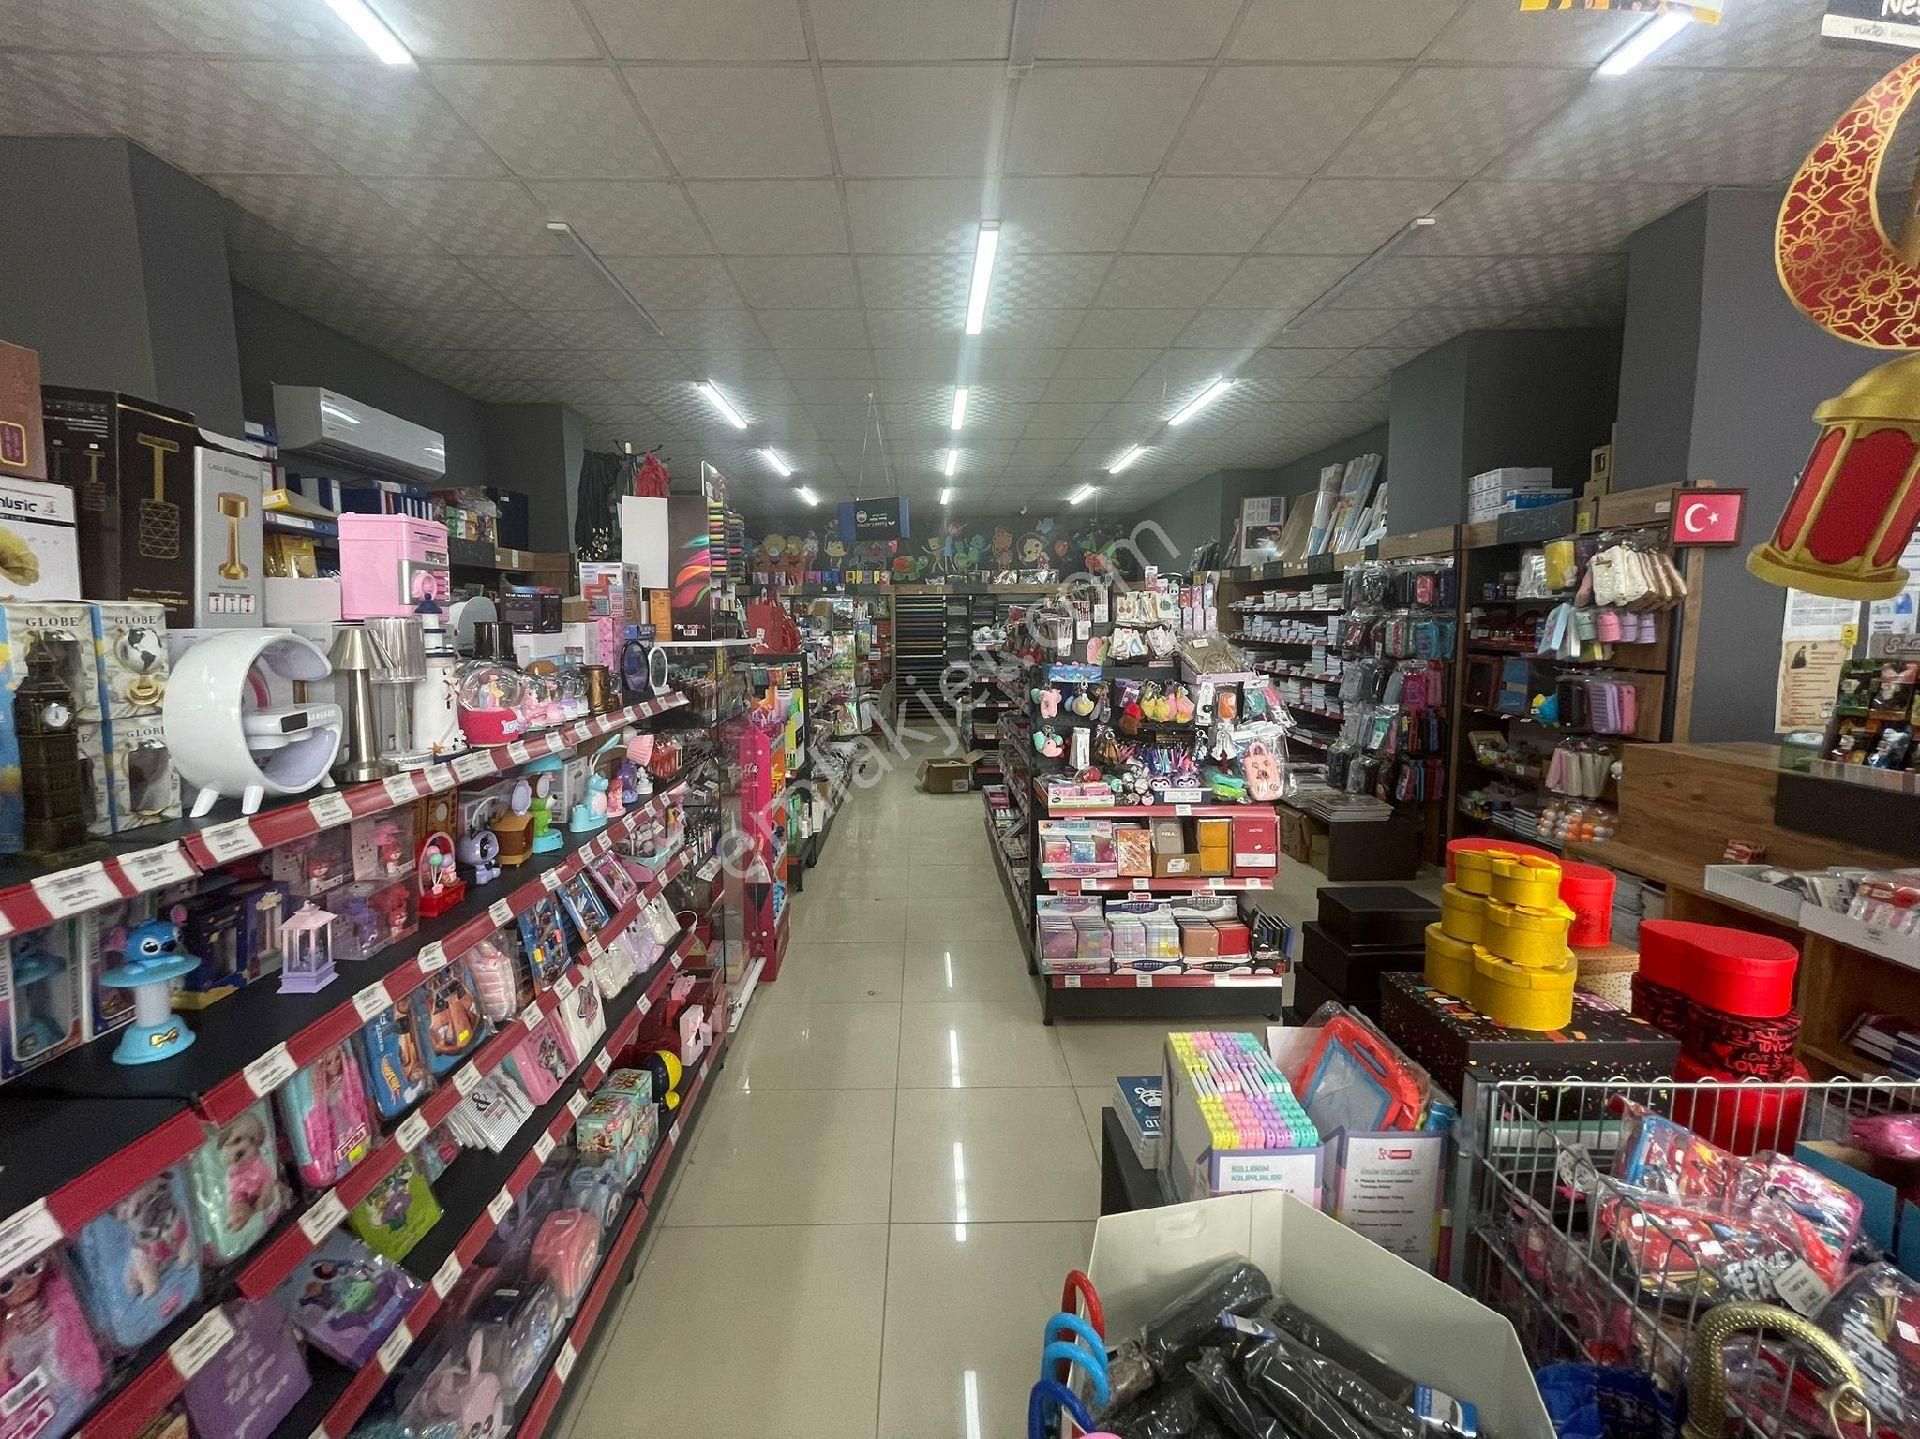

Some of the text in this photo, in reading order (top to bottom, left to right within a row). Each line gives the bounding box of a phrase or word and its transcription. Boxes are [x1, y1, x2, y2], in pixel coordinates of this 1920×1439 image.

[25, 616, 79, 627] GLOBE
[114, 615, 157, 625] GLOBE
[1724, 1057, 1770, 1076] LOVE
